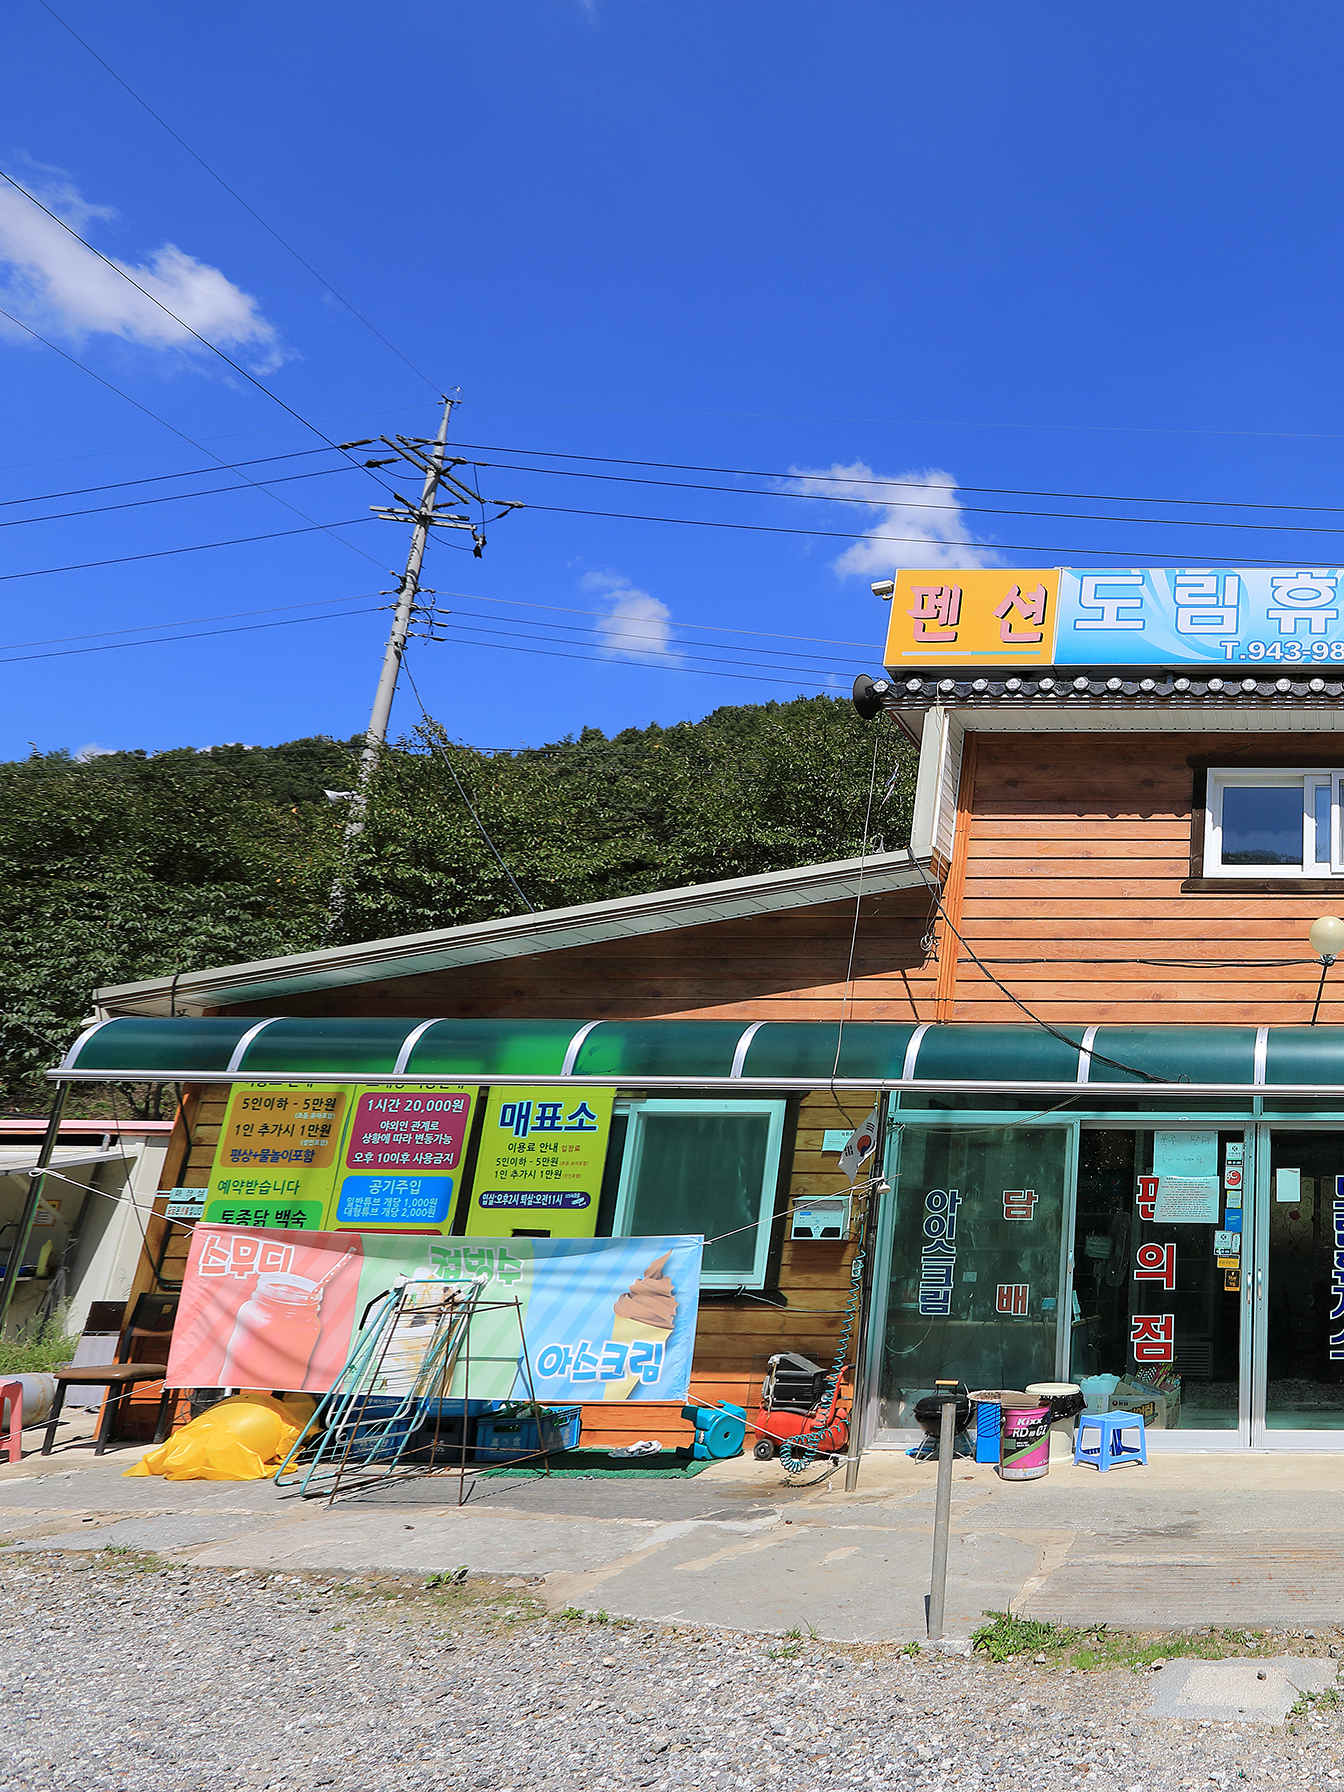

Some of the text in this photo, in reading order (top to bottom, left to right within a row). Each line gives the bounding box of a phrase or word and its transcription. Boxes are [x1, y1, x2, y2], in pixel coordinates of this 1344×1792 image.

[906, 583, 1048, 643] 펜션
[241, 1097, 289, 1111] 5인이하
[302, 1097, 337, 1111] 5만원
[367, 1098, 465, 1113] 1시간 20,000원
[379, 1120, 440, 1132] 야외인 관계로
[498, 1100, 599, 1138] 매표소
[235, 1123, 332, 1138] 1인 추가시 1만원
[361, 1133, 453, 1145] 상황에 따라 변동가능
[507, 1142, 536, 1153] 이용료
[539, 1142, 558, 1153] 안내
[352, 1151, 374, 1164] 오후
[412, 1152, 454, 1165] 사용금지
[495, 1157, 527, 1167] 5인이하
[535, 1157, 559, 1167] 5만원
[494, 1169, 508, 1179] 1인
[510, 1169, 536, 1179] 추가시
[540, 1170, 563, 1180] 1만원
[217, 1179, 300, 1196] 예약받습니다
[368, 1179, 422, 1195] 공기주입
[382, 1197, 402, 1208] 개당
[404, 1197, 438, 1208] 1,000원
[275, 1209, 307, 1229] 백숙
[343, 1207, 436, 1218] 대형튜브 개당 2,000원
[918, 1188, 962, 1316] 아이스크림
[1016, 1417, 1044, 1426] Kixx
